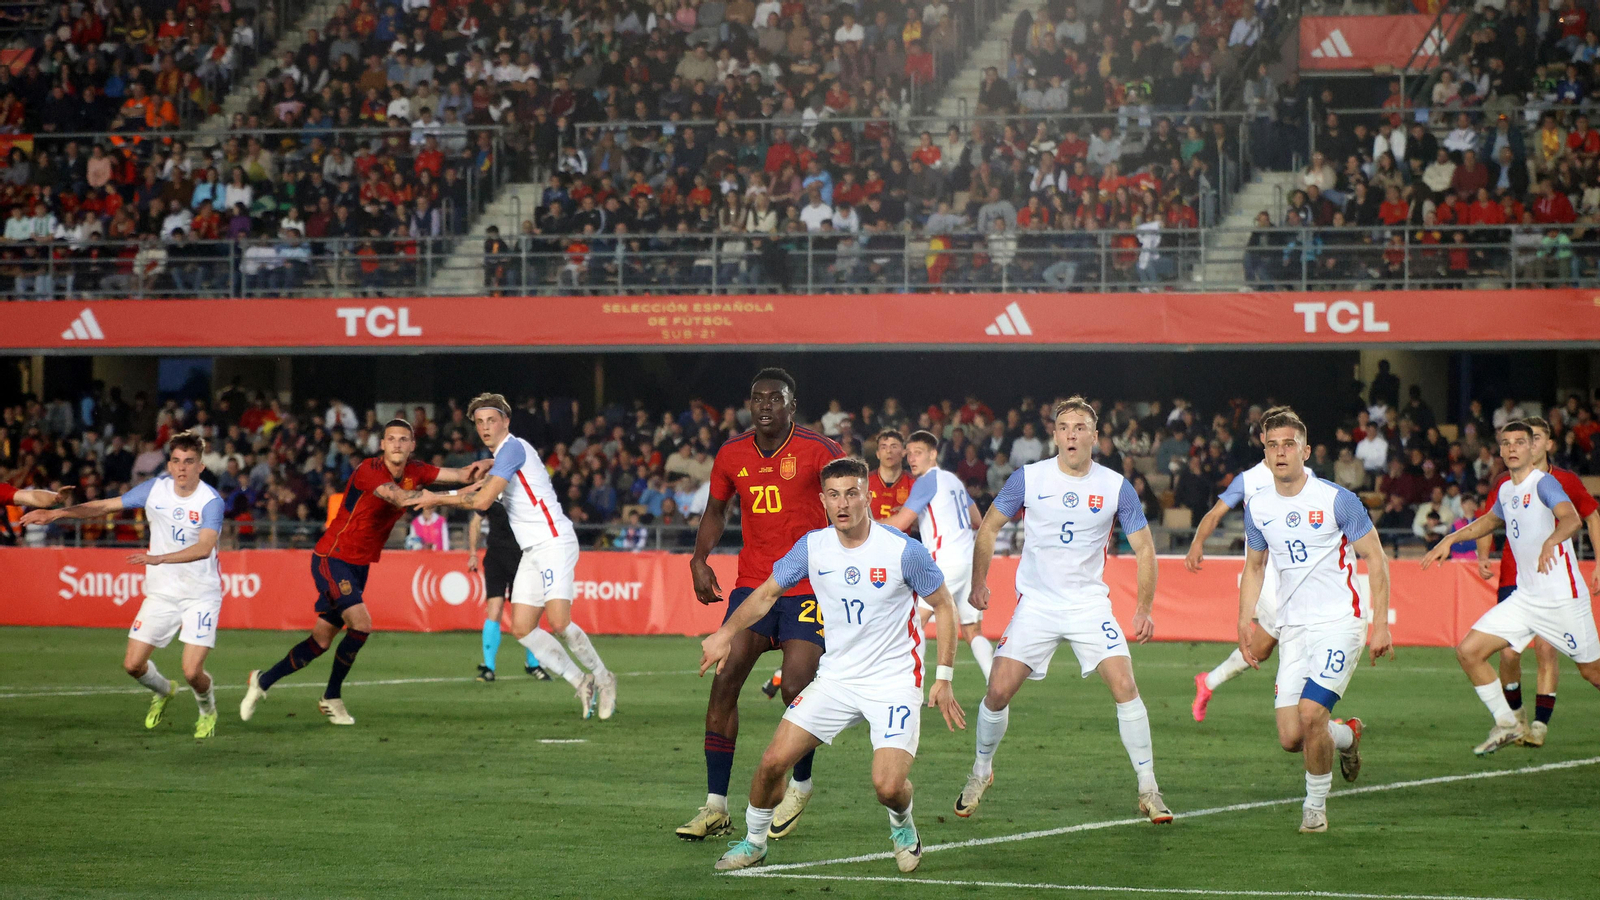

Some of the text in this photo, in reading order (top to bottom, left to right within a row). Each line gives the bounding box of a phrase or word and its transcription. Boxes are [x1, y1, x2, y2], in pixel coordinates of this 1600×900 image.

[602, 301, 774, 313] SELECCIÓN ESPAÑOLA
[1294, 301, 1390, 333] TCL
[336, 306, 422, 337] TCL
[648, 315, 732, 326] DE FÚTBOL
[661, 329, 716, 339] SUB-21
[749, 485, 782, 513] 20
[880, 504, 891, 518] 5
[171, 525, 186, 545] 14
[1060, 521, 1074, 544] 5
[1510, 519, 1520, 539] 3
[1285, 539, 1308, 563] 13
[540, 568, 554, 588] 19
[841, 598, 864, 624] 17
[197, 612, 211, 631] 14
[1101, 622, 1119, 640] 5
[1564, 633, 1577, 650] 3
[1325, 649, 1346, 673] 13
[888, 706, 911, 729] 17
